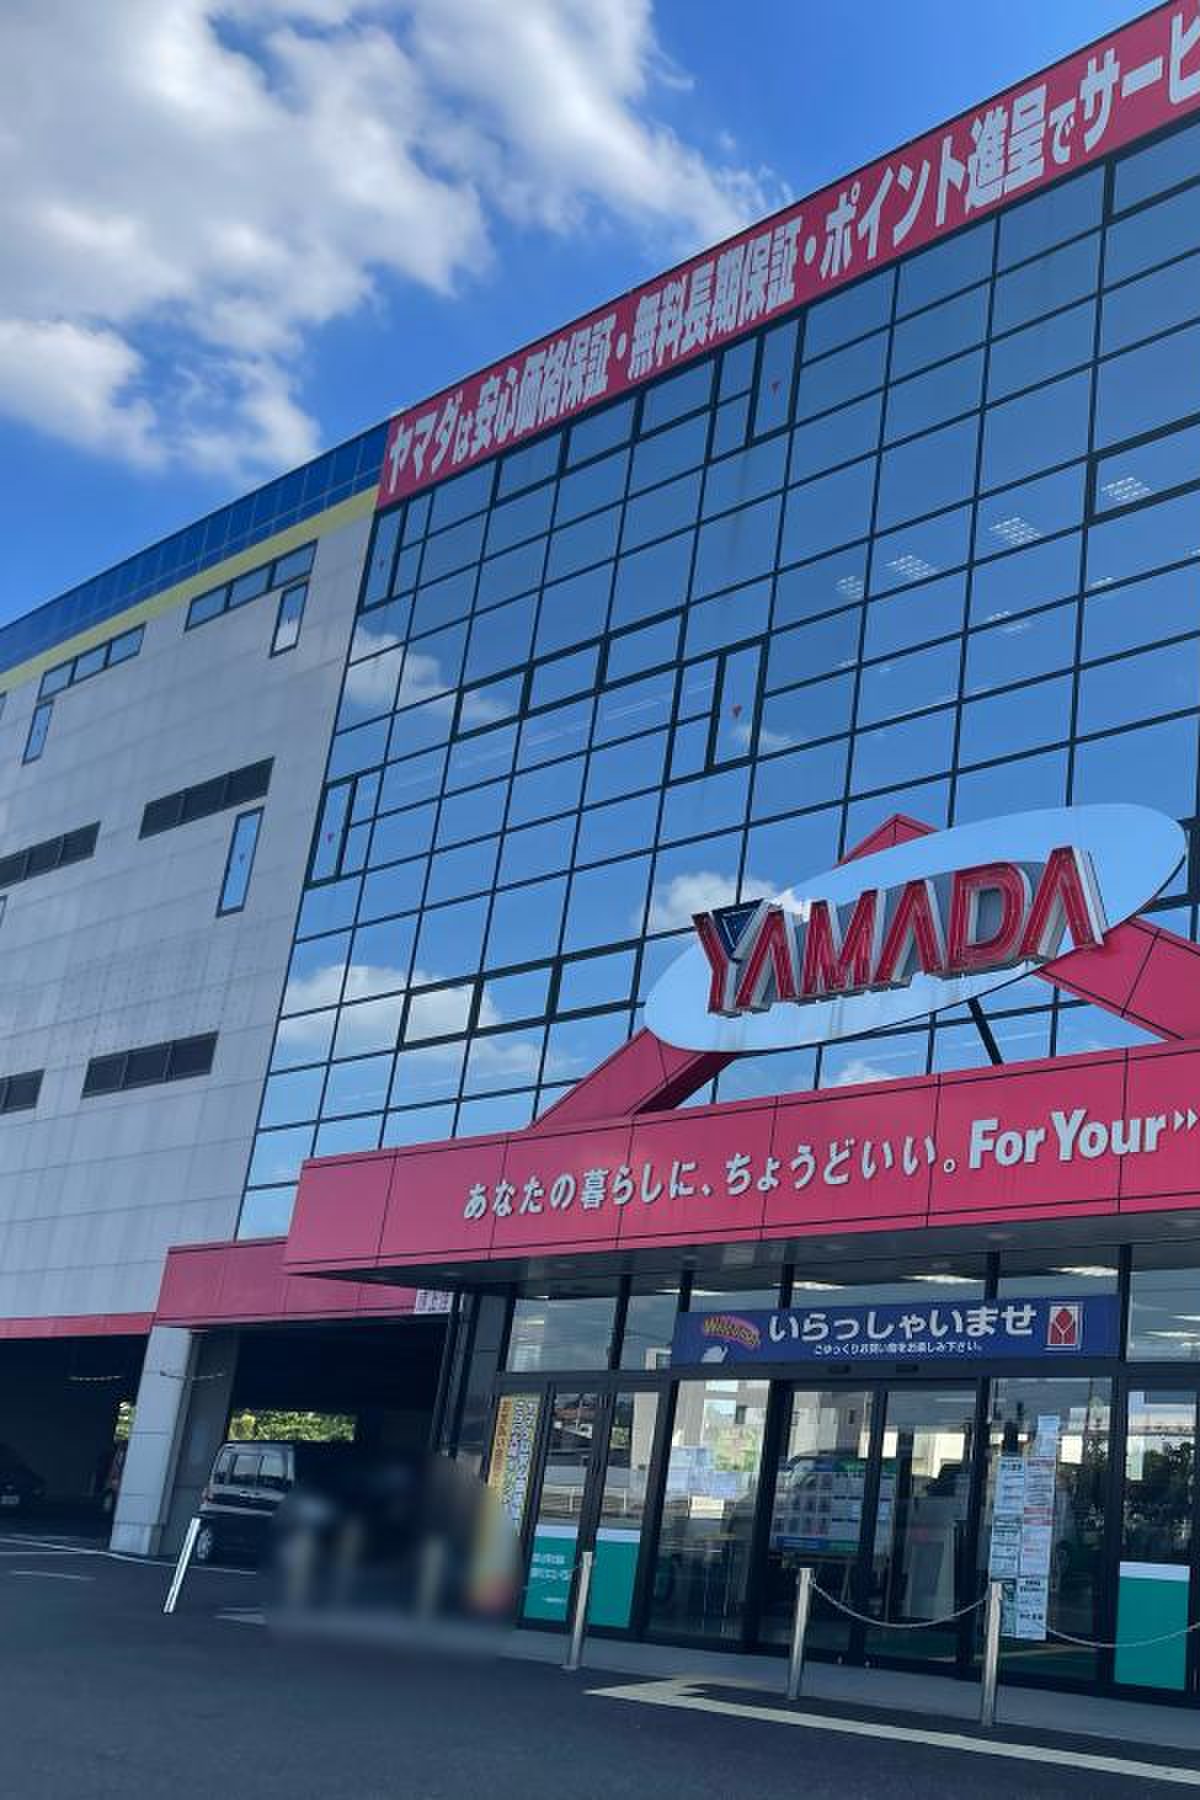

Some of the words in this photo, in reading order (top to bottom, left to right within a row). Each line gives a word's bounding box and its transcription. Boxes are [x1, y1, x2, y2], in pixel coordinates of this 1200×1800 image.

[692, 845, 1106, 1016] YAMADA
[463, 1134, 956, 1220] あなたの暮らしに、ちょうどいい。
[969, 1118, 1046, 1169] For
[1051, 1109, 1167, 1163] Your
[768, 1303, 1037, 1343] いらっしゃいませ
